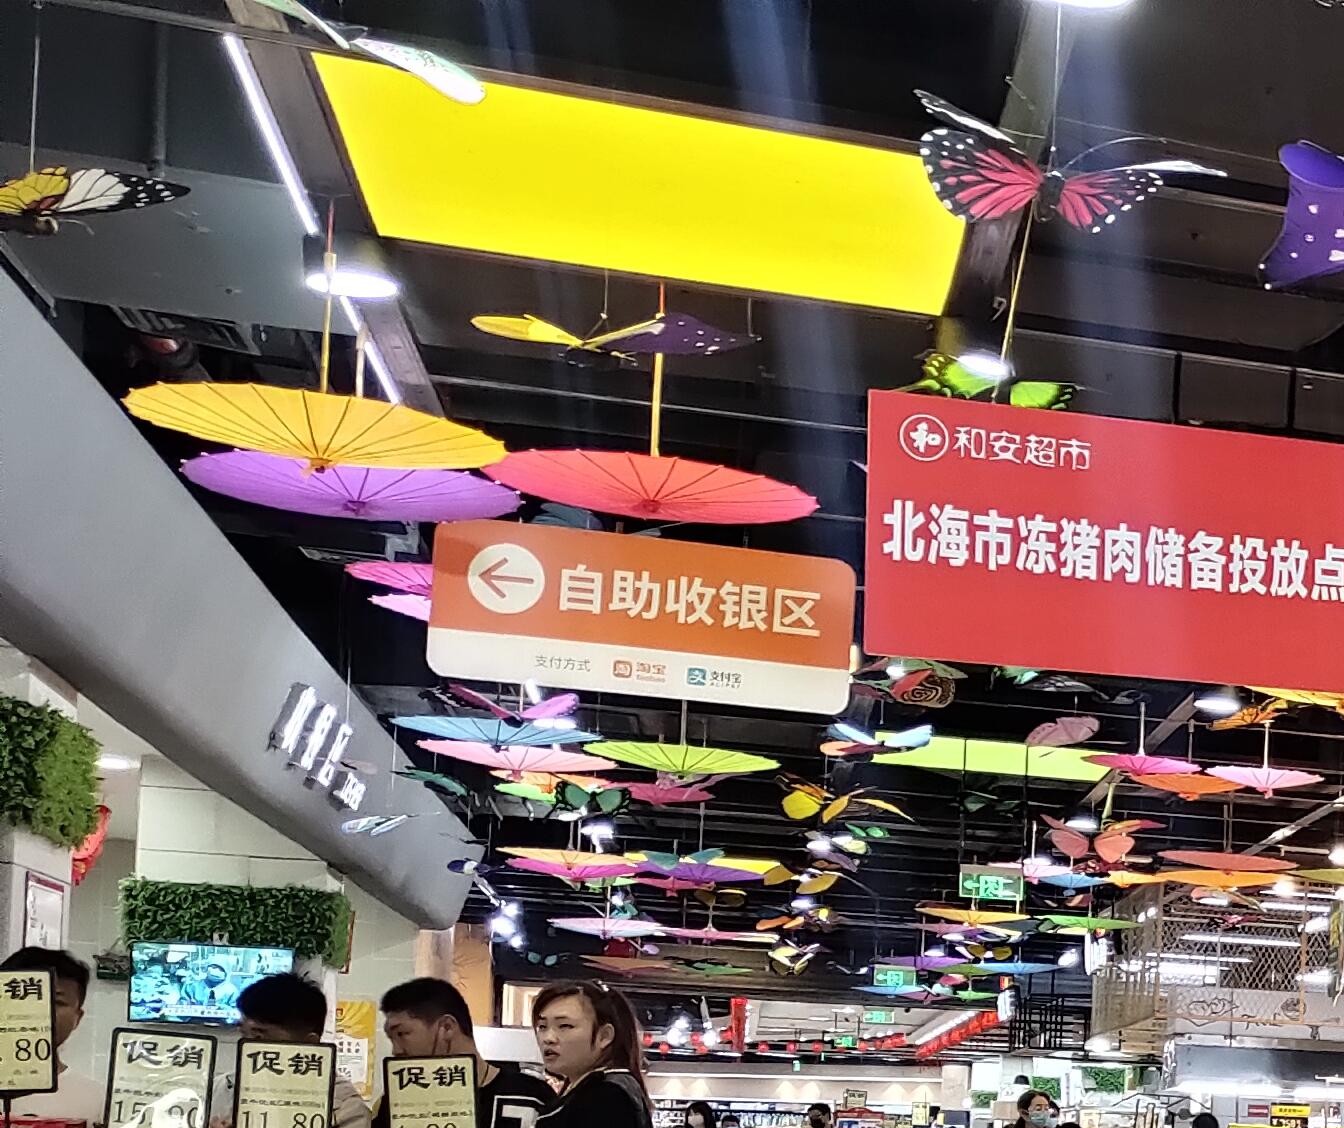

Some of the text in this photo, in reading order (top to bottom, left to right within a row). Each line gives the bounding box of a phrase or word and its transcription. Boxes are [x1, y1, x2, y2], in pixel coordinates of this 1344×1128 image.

[952, 425, 1093, 471] 和安超市
[558, 564, 822, 638] 自助收银区
[535, 655, 592, 673] 支付方式
[636, 661, 667, 676] 淘宝
[709, 670, 742, 684] 支付宝
[3, 977, 43, 1001] 销
[122, 1040, 205, 1069] 促销
[246, 1050, 325, 1077] 促销
[392, 1064, 467, 1090] 促销
